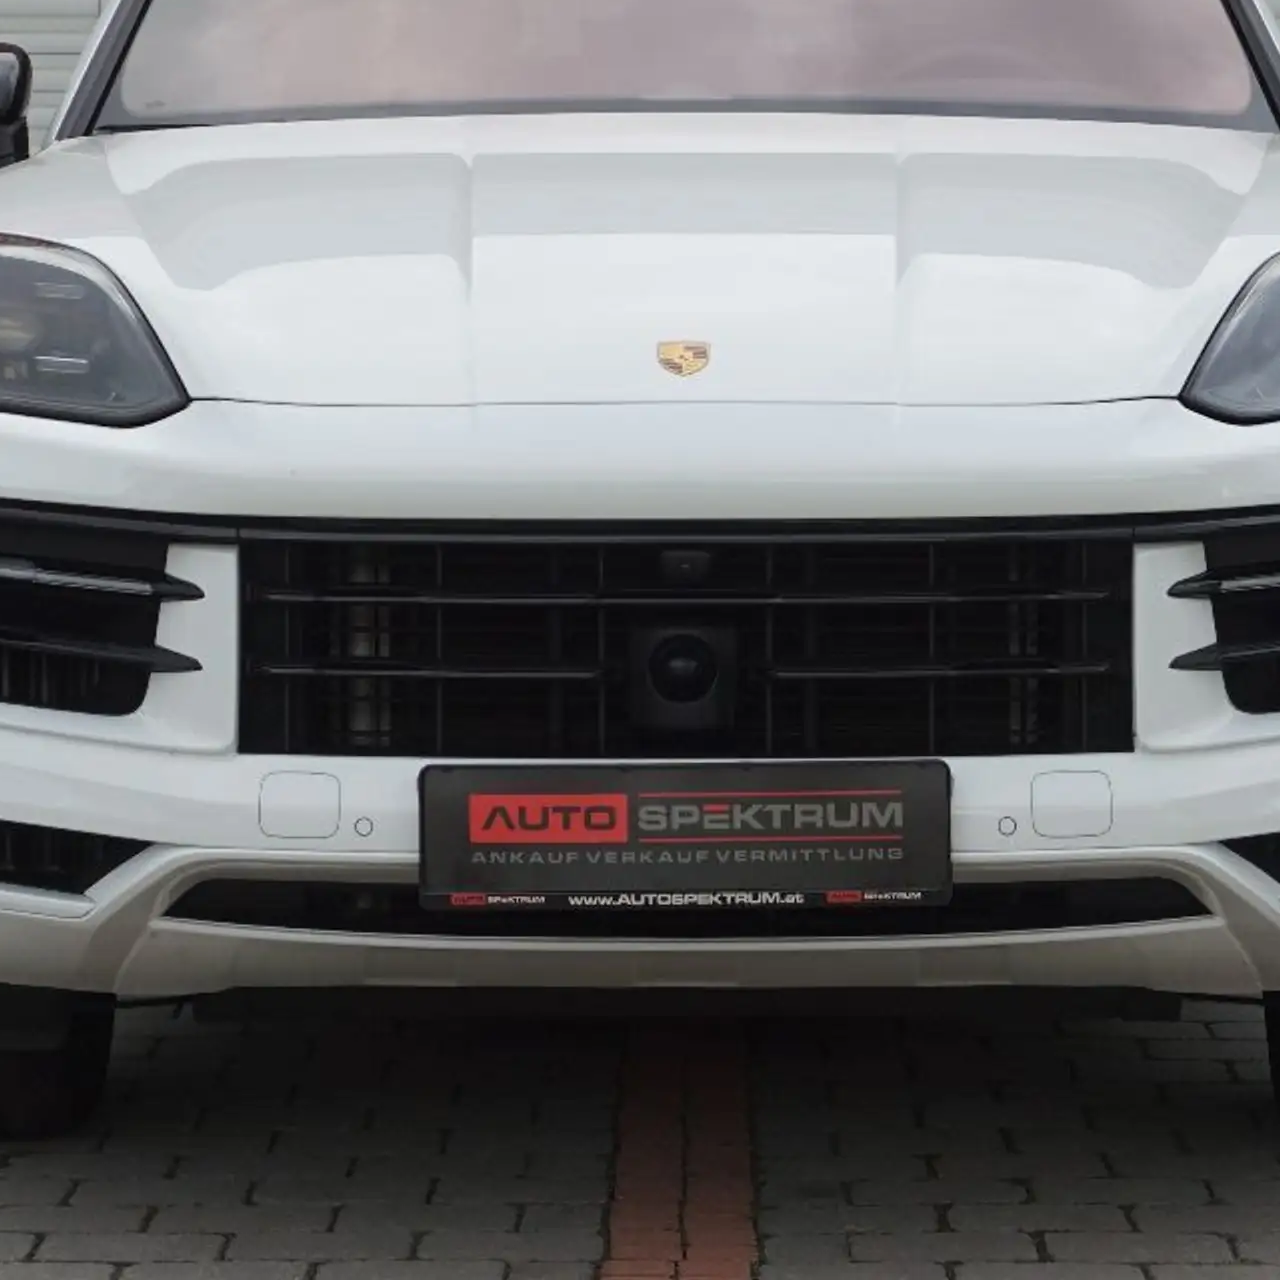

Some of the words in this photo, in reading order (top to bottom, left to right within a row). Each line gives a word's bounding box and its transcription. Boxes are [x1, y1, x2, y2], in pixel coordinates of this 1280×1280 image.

[481, 805, 616, 831] AUTO
[638, 802, 903, 830] SPEKTRUM
[472, 850, 579, 864] ANKAUF
[586, 849, 709, 864] VERKAUF
[716, 847, 903, 863] VERMITTLUNG
[568, 891, 804, 906] www.AUTOSPEKTRUM.at
